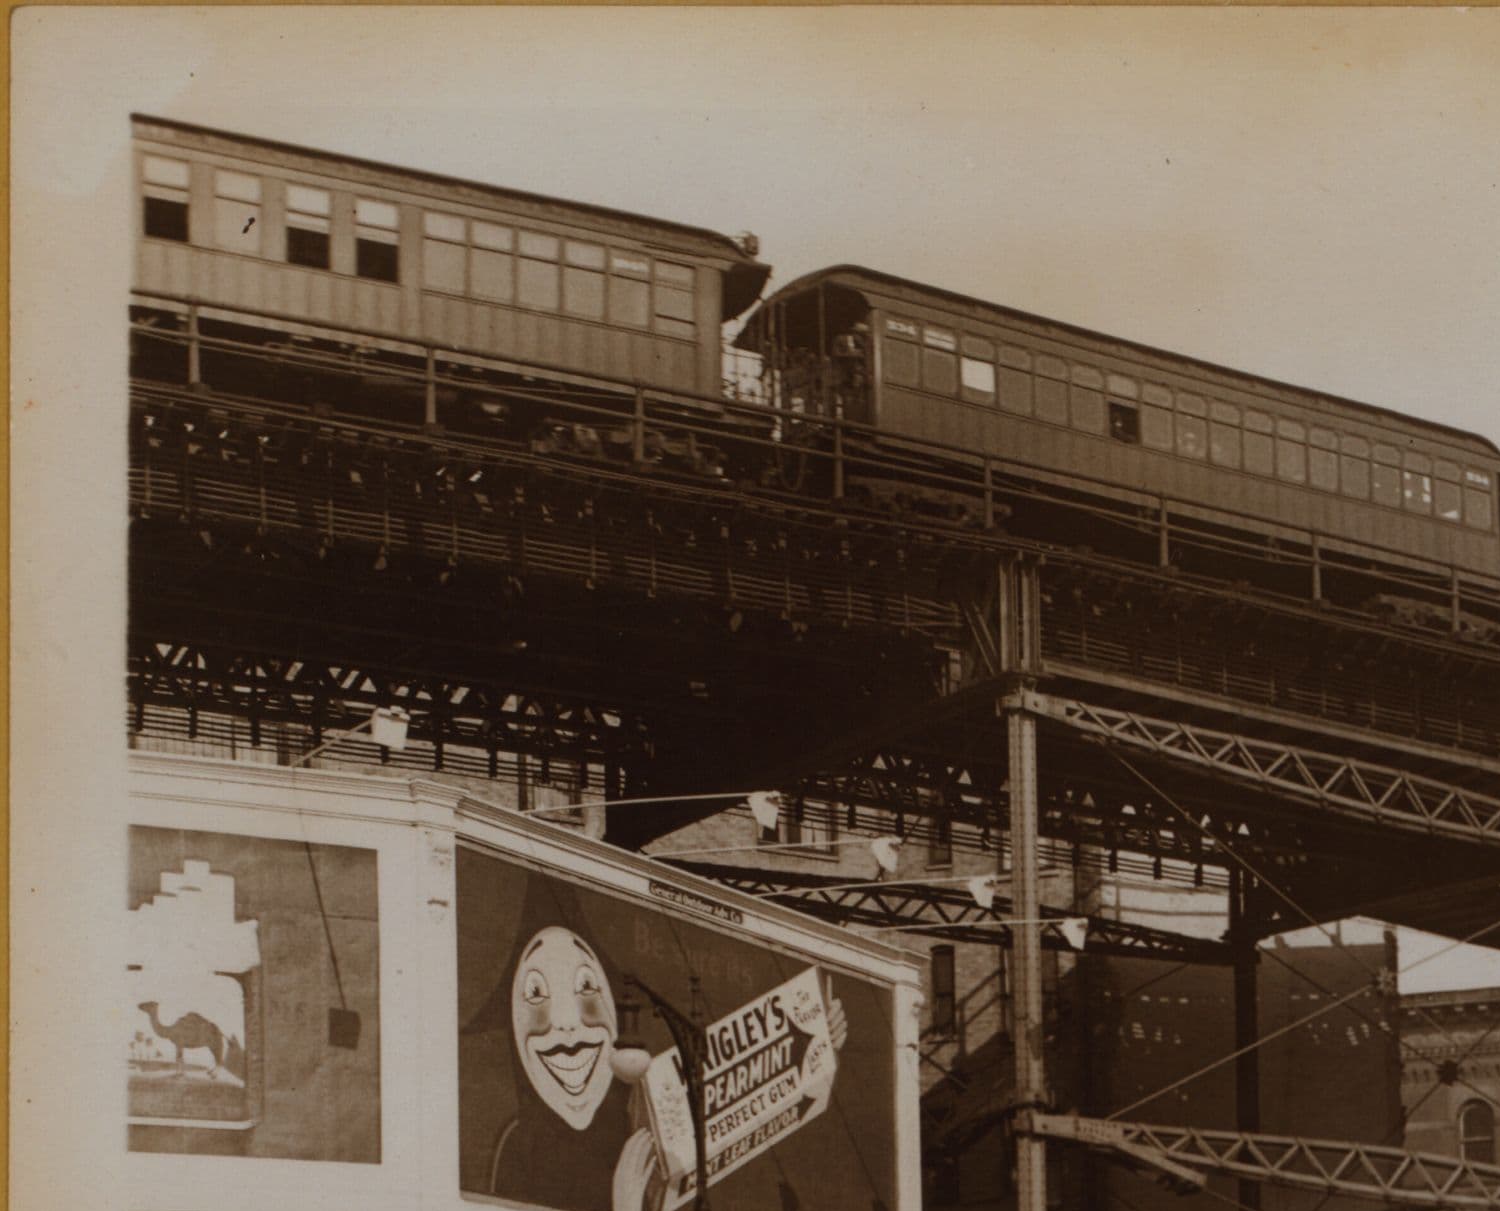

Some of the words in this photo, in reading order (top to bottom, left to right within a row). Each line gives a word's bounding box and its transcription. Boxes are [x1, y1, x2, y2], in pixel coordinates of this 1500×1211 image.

[672, 995, 786, 1086] IGLEY'S
[684, 1034, 795, 1117] PEARMINT
[708, 1093, 766, 1143] PERFECT
[767, 1073, 798, 1105] GUM
